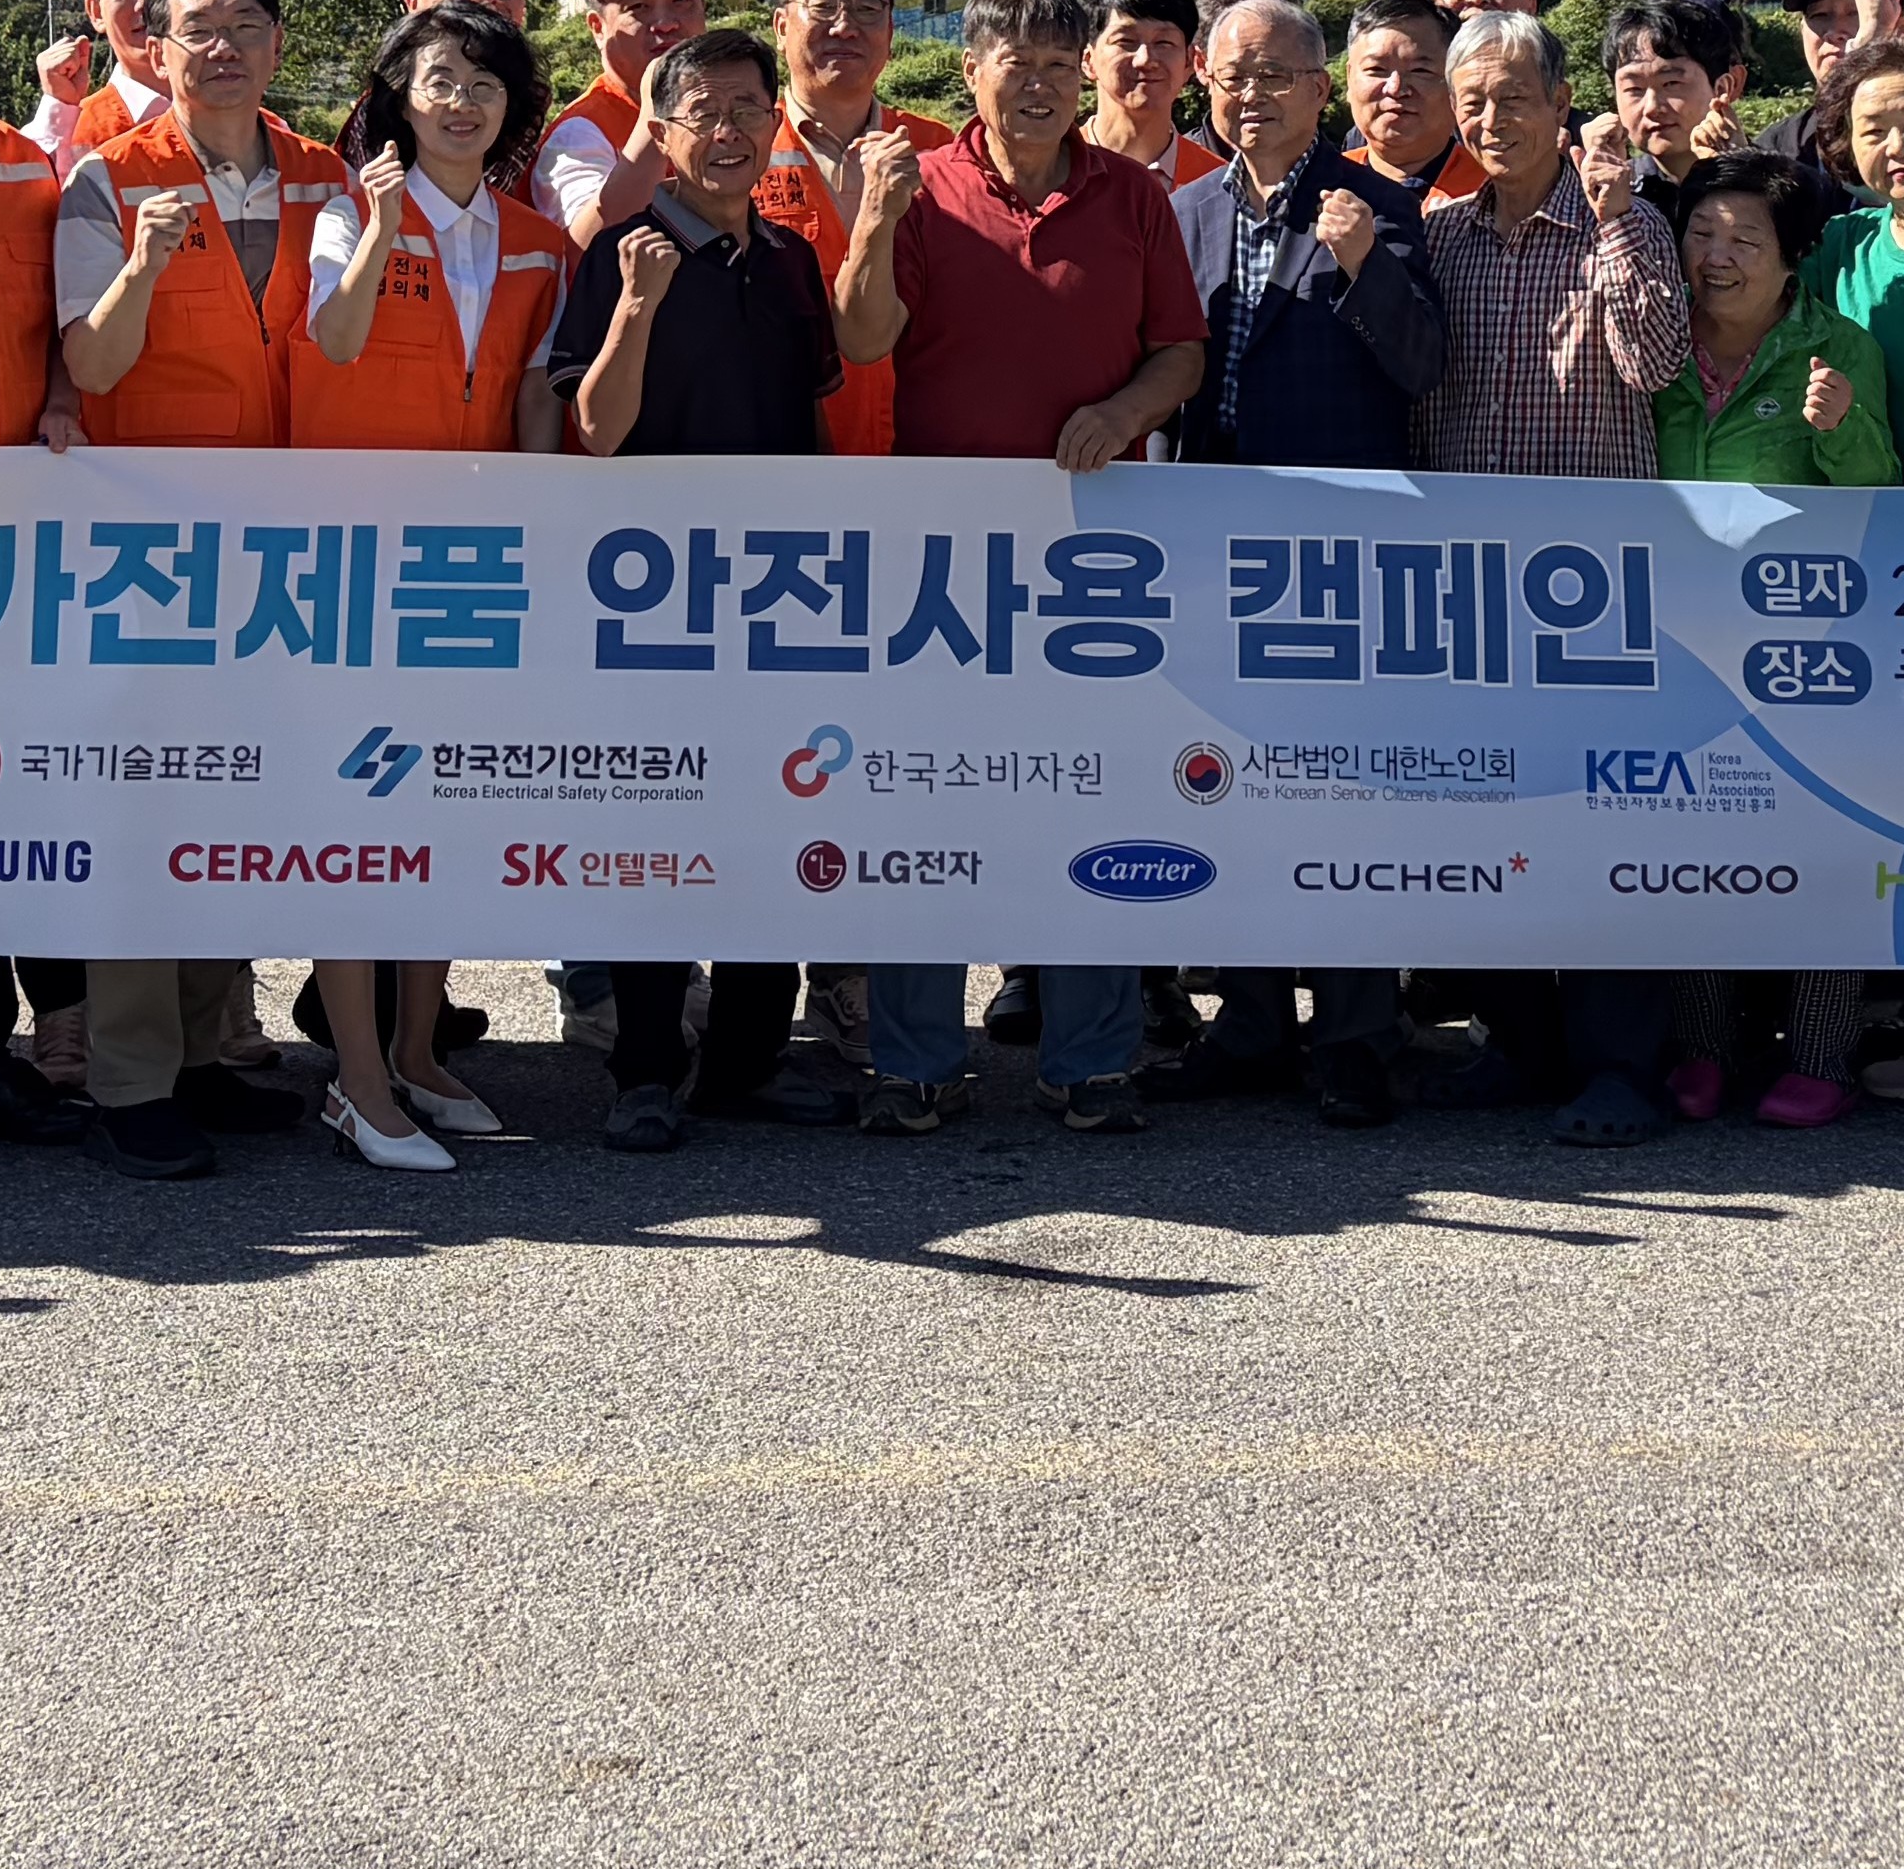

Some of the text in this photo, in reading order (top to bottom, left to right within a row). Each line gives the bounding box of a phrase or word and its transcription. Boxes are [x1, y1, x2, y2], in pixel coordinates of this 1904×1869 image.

[757, 172, 801, 189] 전사
[383, 257, 429, 280] 전사
[1757, 558, 1853, 614] 일자
[587, 527, 1173, 678] 안전사용
[1227, 535, 1658, 690] 캠페인
[1759, 645, 1856, 699] 장소
[21, 744, 262, 781] 국가기술표준원
[432, 743, 708, 780] 한국전기안전공사
[862, 750, 1103, 796] 한국소비자원
[1241, 743, 1515, 783] 사단법인 대한노인회
[1586, 749, 1697, 795] KEA
[1708, 752, 1741, 765] Korea
[1708, 768, 1772, 781] Electronics
[433, 784, 704, 803] Korea Electrical Safety Corporation
[1241, 783, 1269, 799] The
[1275, 784, 1326, 801] Korean
[1330, 785, 1377, 801] Senior
[1708, 783, 1776, 797] Association
[168, 842, 431, 883] CERAGEM
[501, 842, 716, 887] SK 인텔릭스
[857, 850, 983, 885] LG전자
[1090, 854, 1197, 882] Carrier
[1293, 862, 1503, 893] CUCHEN
[1608, 863, 1799, 894] CUCKOO
